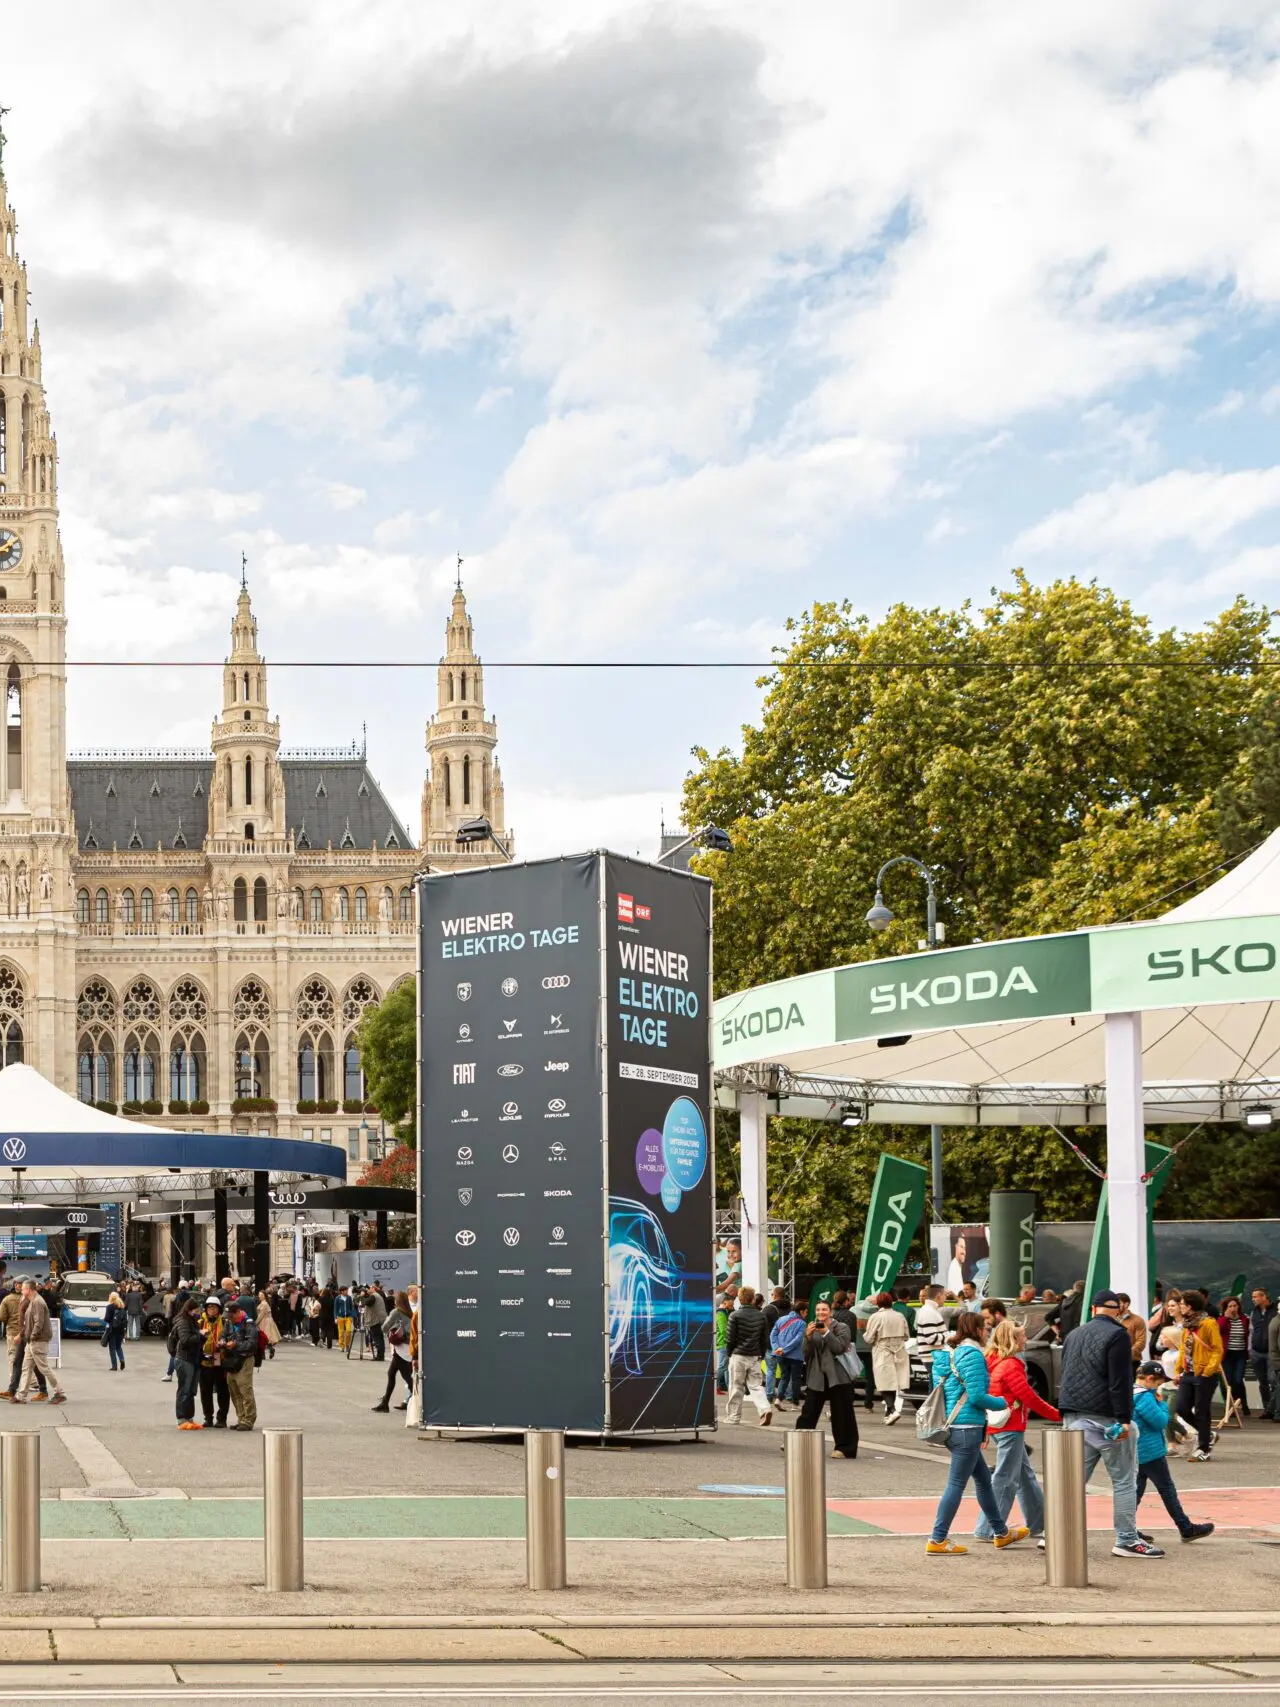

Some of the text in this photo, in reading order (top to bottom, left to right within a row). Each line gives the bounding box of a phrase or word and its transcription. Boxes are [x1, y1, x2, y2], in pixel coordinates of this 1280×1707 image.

[442, 912, 514, 936] WIENER
[636, 907, 650, 918] ORF
[442, 926, 579, 959] ELEKTRO TAGE
[619, 940, 688, 982] WIENER
[620, 977, 698, 1018] ELEKTRO
[620, 1013, 668, 1048] TAGE
[453, 1063, 476, 1085] FIAT
[544, 1061, 569, 1072] Jeep
[647, 1069, 683, 1084] SEPTEMBER
[684, 1074, 697, 1086] 2025
